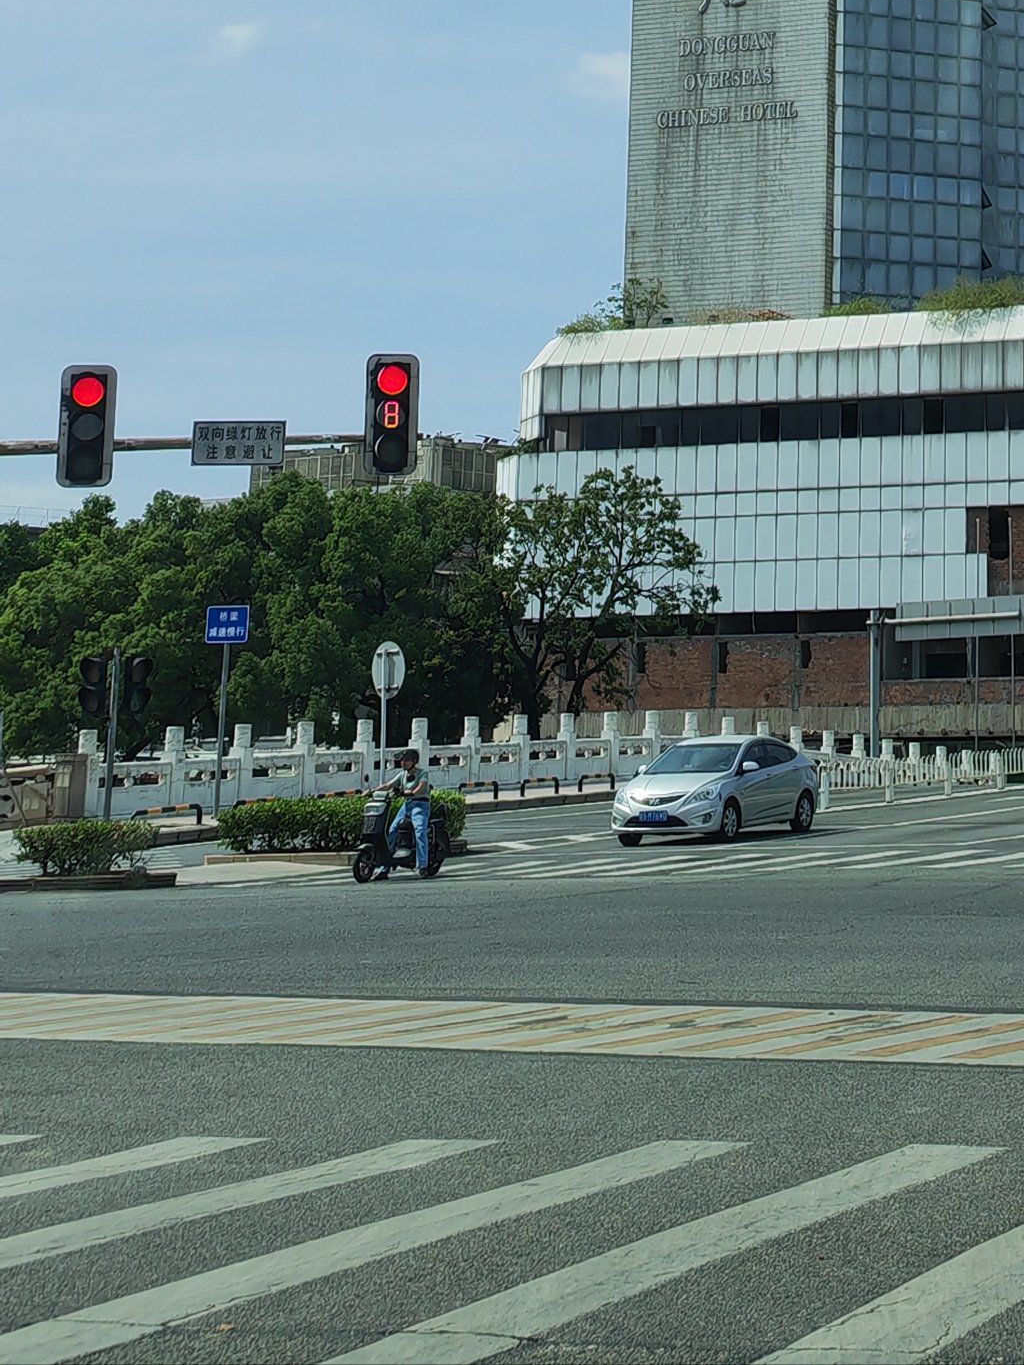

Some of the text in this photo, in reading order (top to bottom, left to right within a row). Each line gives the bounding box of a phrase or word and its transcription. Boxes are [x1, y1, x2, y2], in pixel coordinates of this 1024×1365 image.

[679, 31, 776, 56] DONGGUAN
[684, 67, 773, 91] OVERSEAS
[656, 101, 798, 128] CHINESE HOTEL
[384, 401, 399, 428] 8
[197, 425, 282, 441] 双向绿灯放行
[205, 444, 274, 459] 注意避让
[208, 626, 245, 638] 减速慢行
